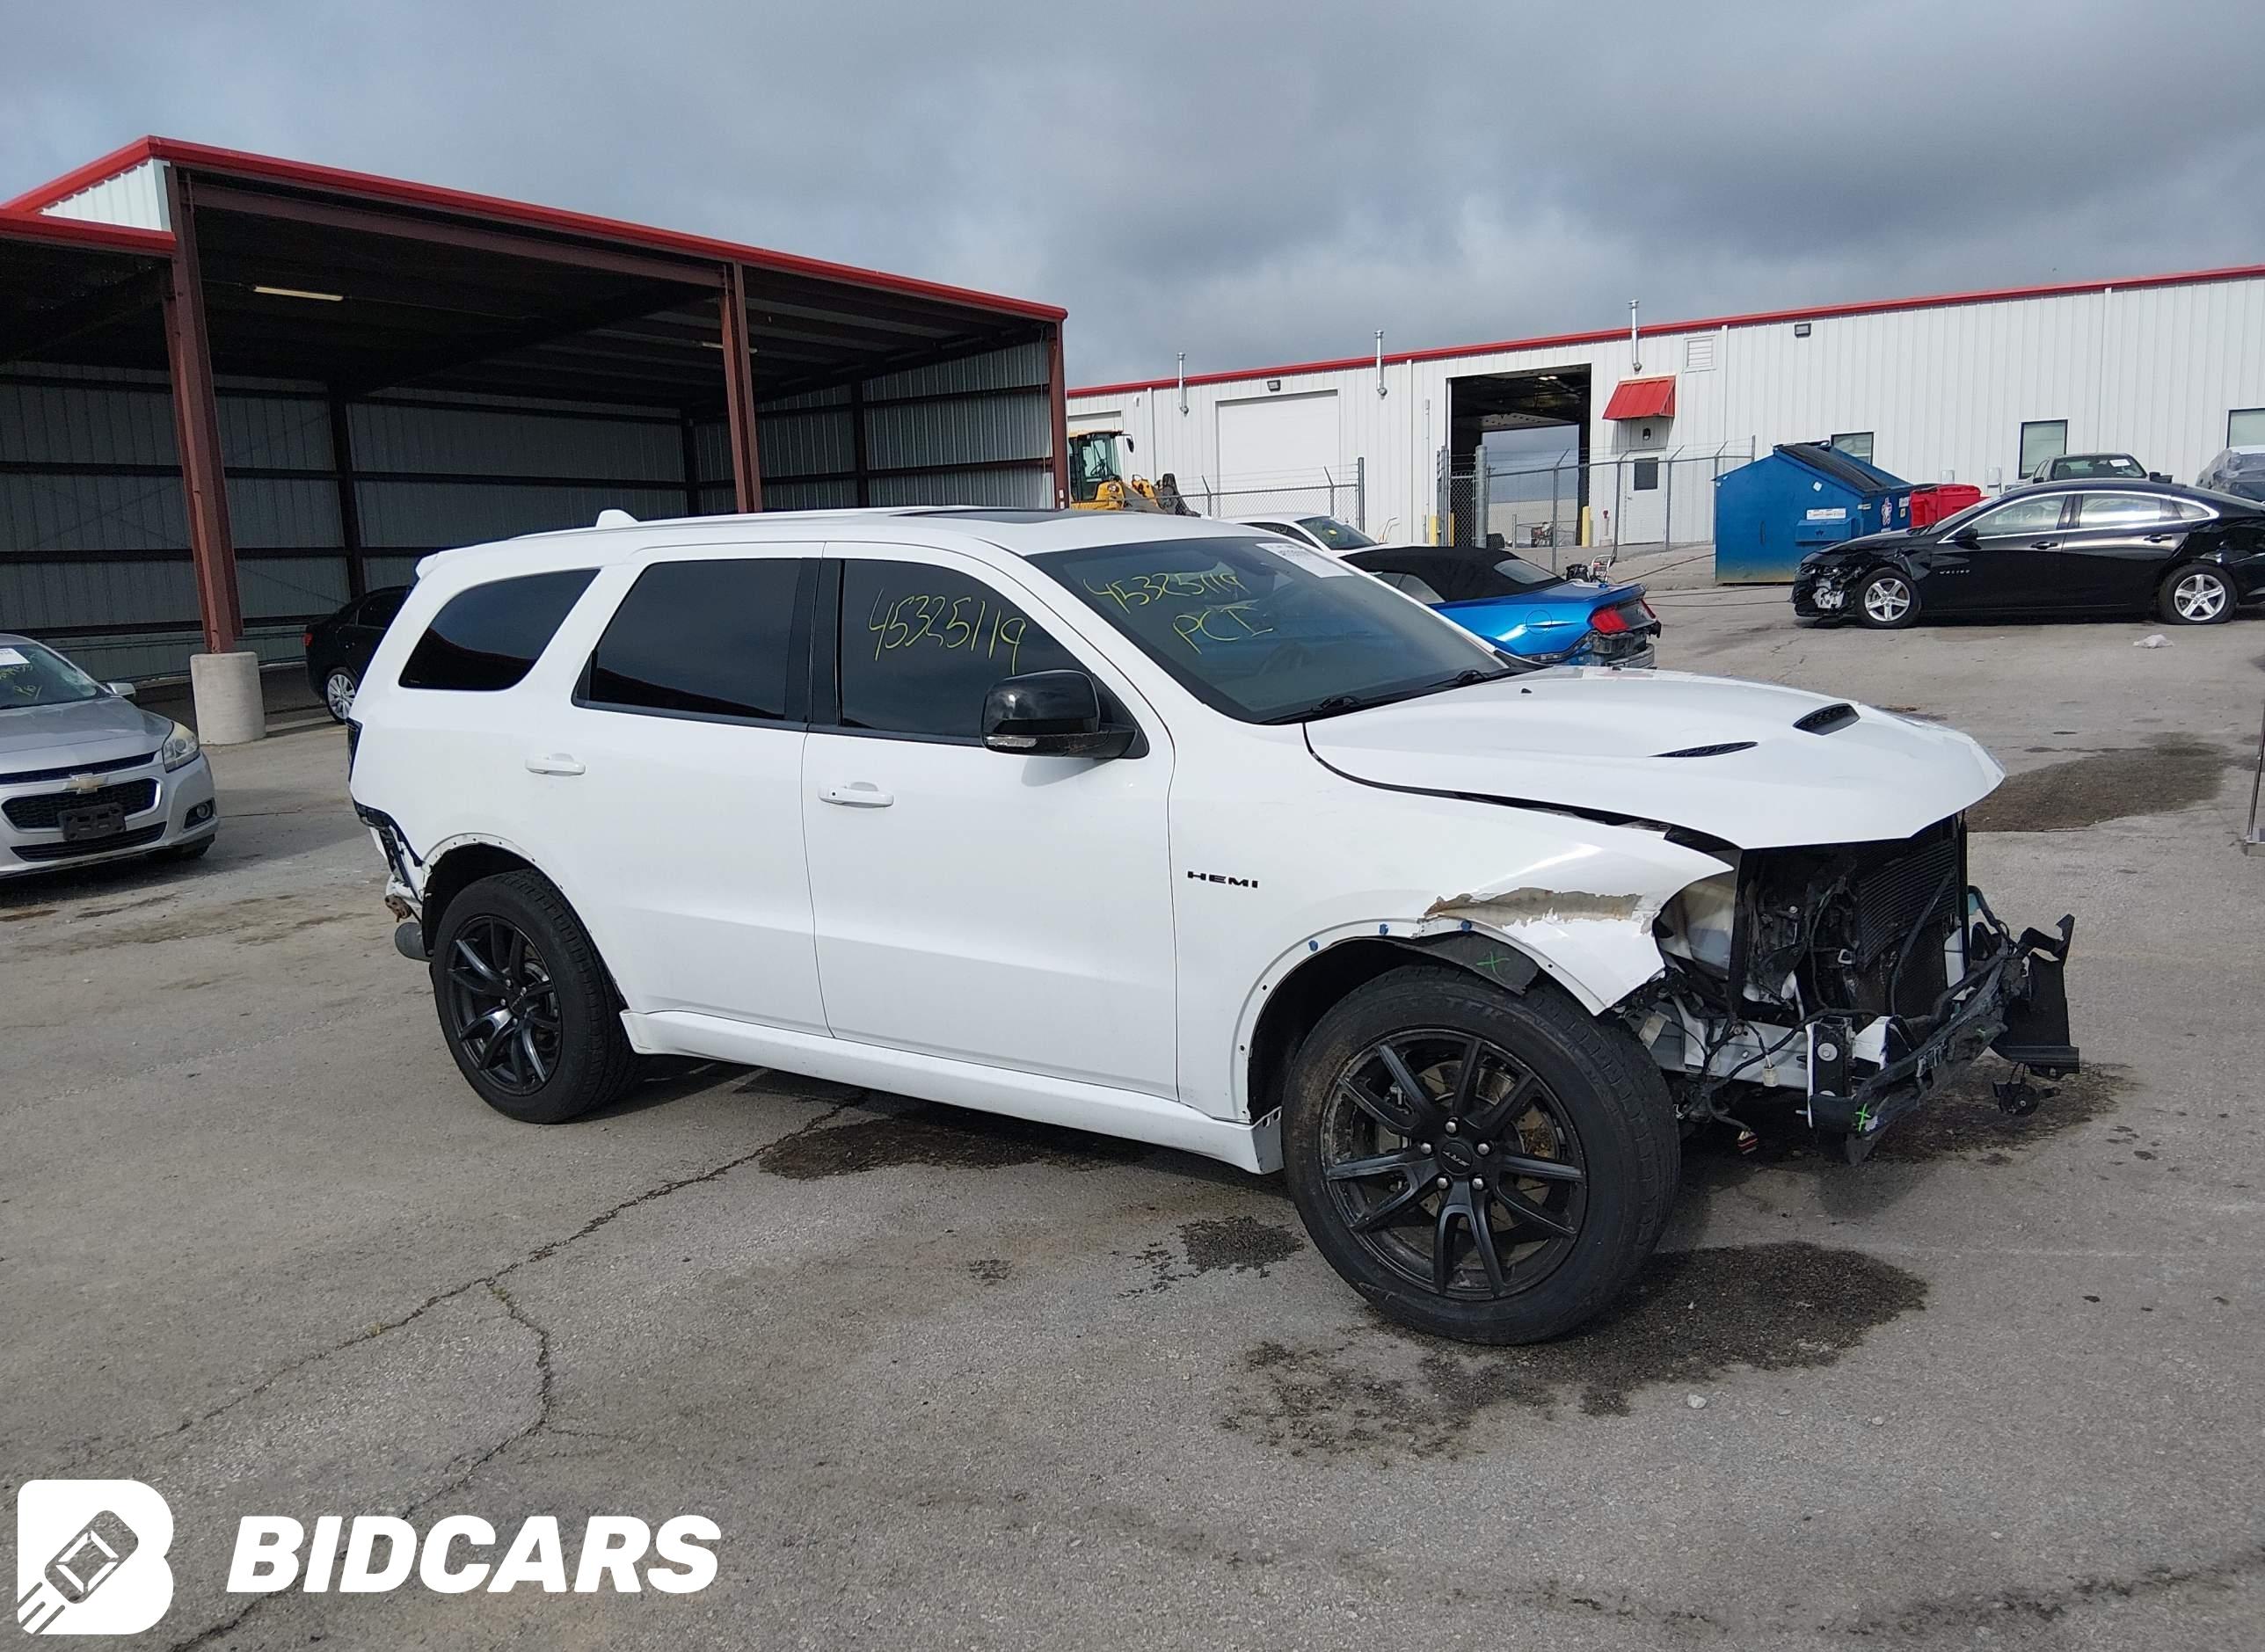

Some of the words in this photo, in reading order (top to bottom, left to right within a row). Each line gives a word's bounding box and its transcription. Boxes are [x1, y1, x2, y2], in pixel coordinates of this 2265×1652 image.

[1082, 572, 1251, 615] 45325119
[868, 586, 1027, 676] 45325119
[1187, 870, 1258, 889] HEMI
